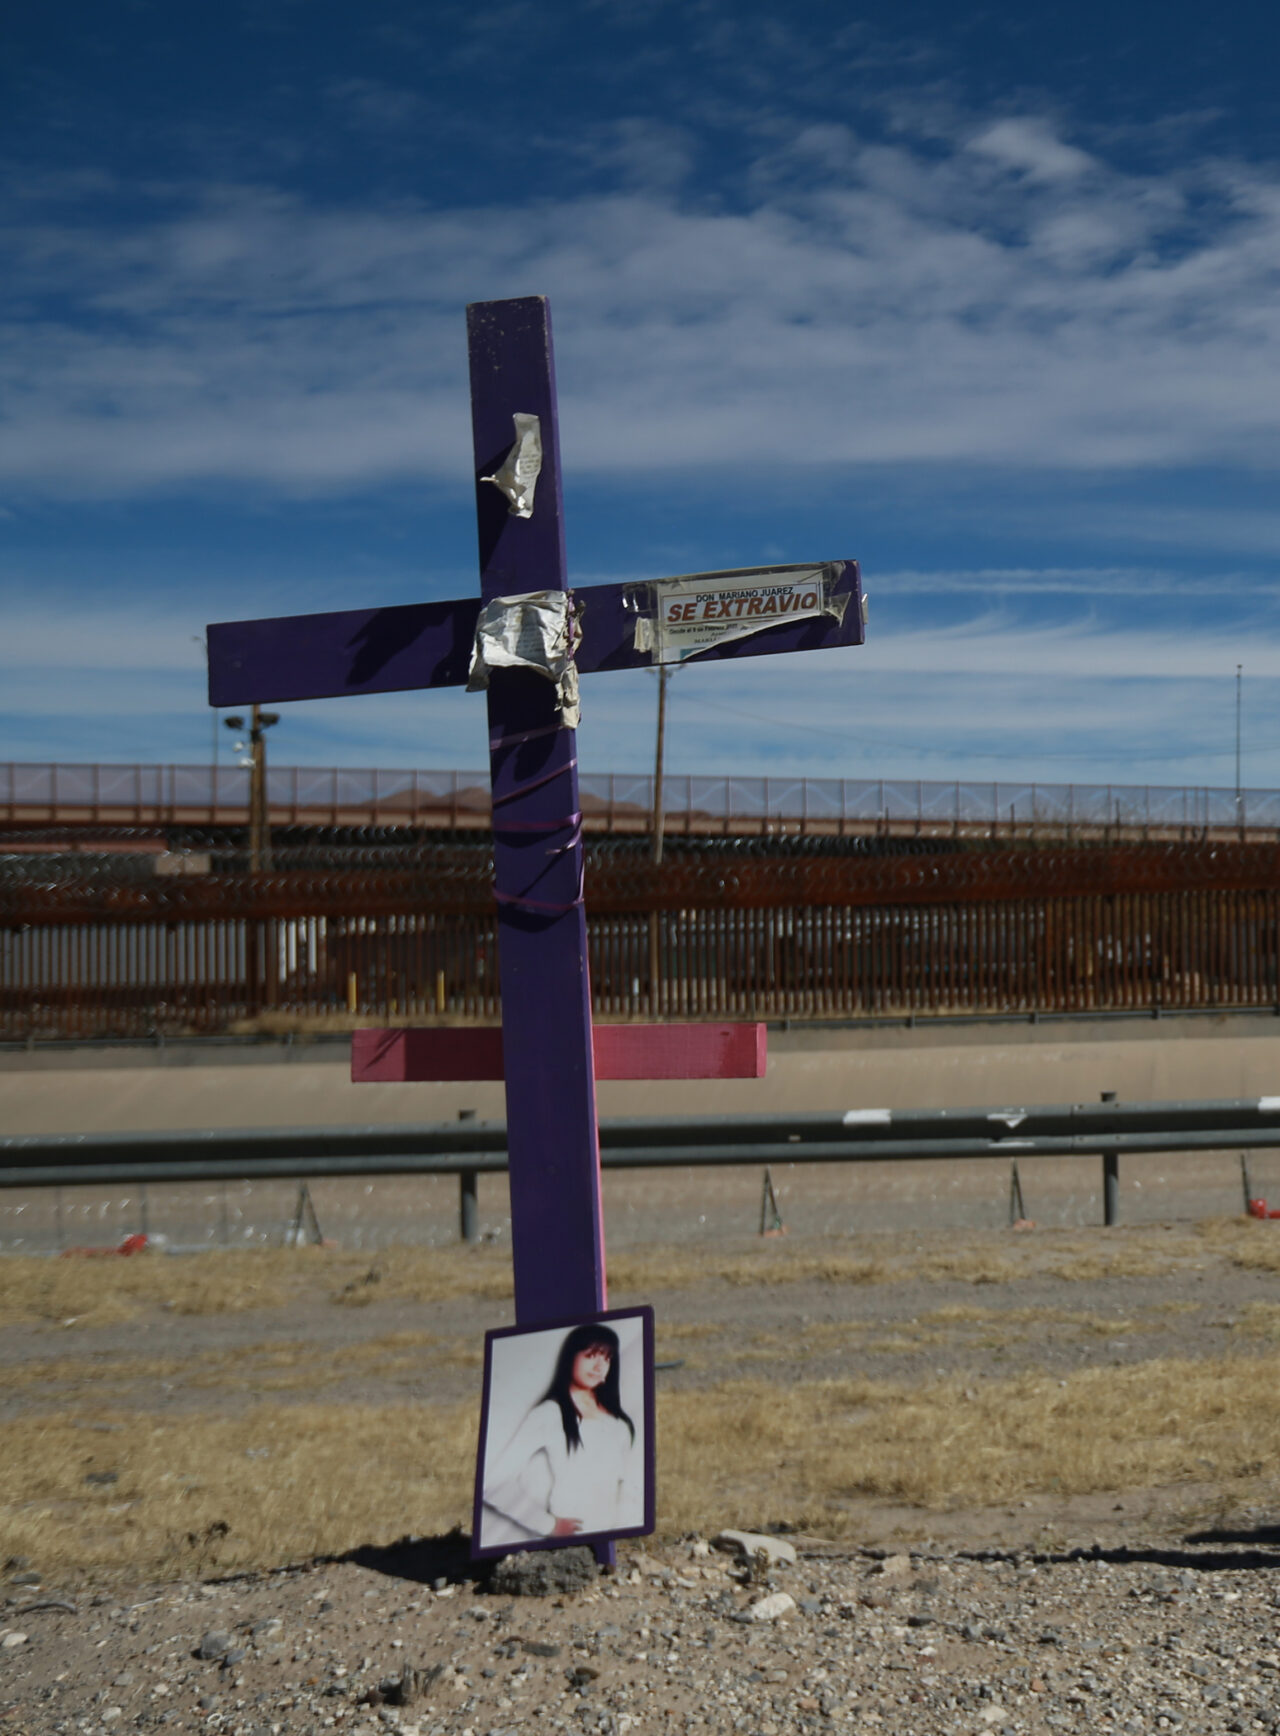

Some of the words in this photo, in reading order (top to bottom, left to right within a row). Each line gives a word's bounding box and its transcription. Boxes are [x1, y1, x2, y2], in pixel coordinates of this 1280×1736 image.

[696, 594, 714, 603] DON
[719, 589, 758, 600] MARIANO
[760, 586, 794, 596] JUAREZ
[667, 602, 697, 622] SE
[702, 592, 818, 619] EXTRAVIO
